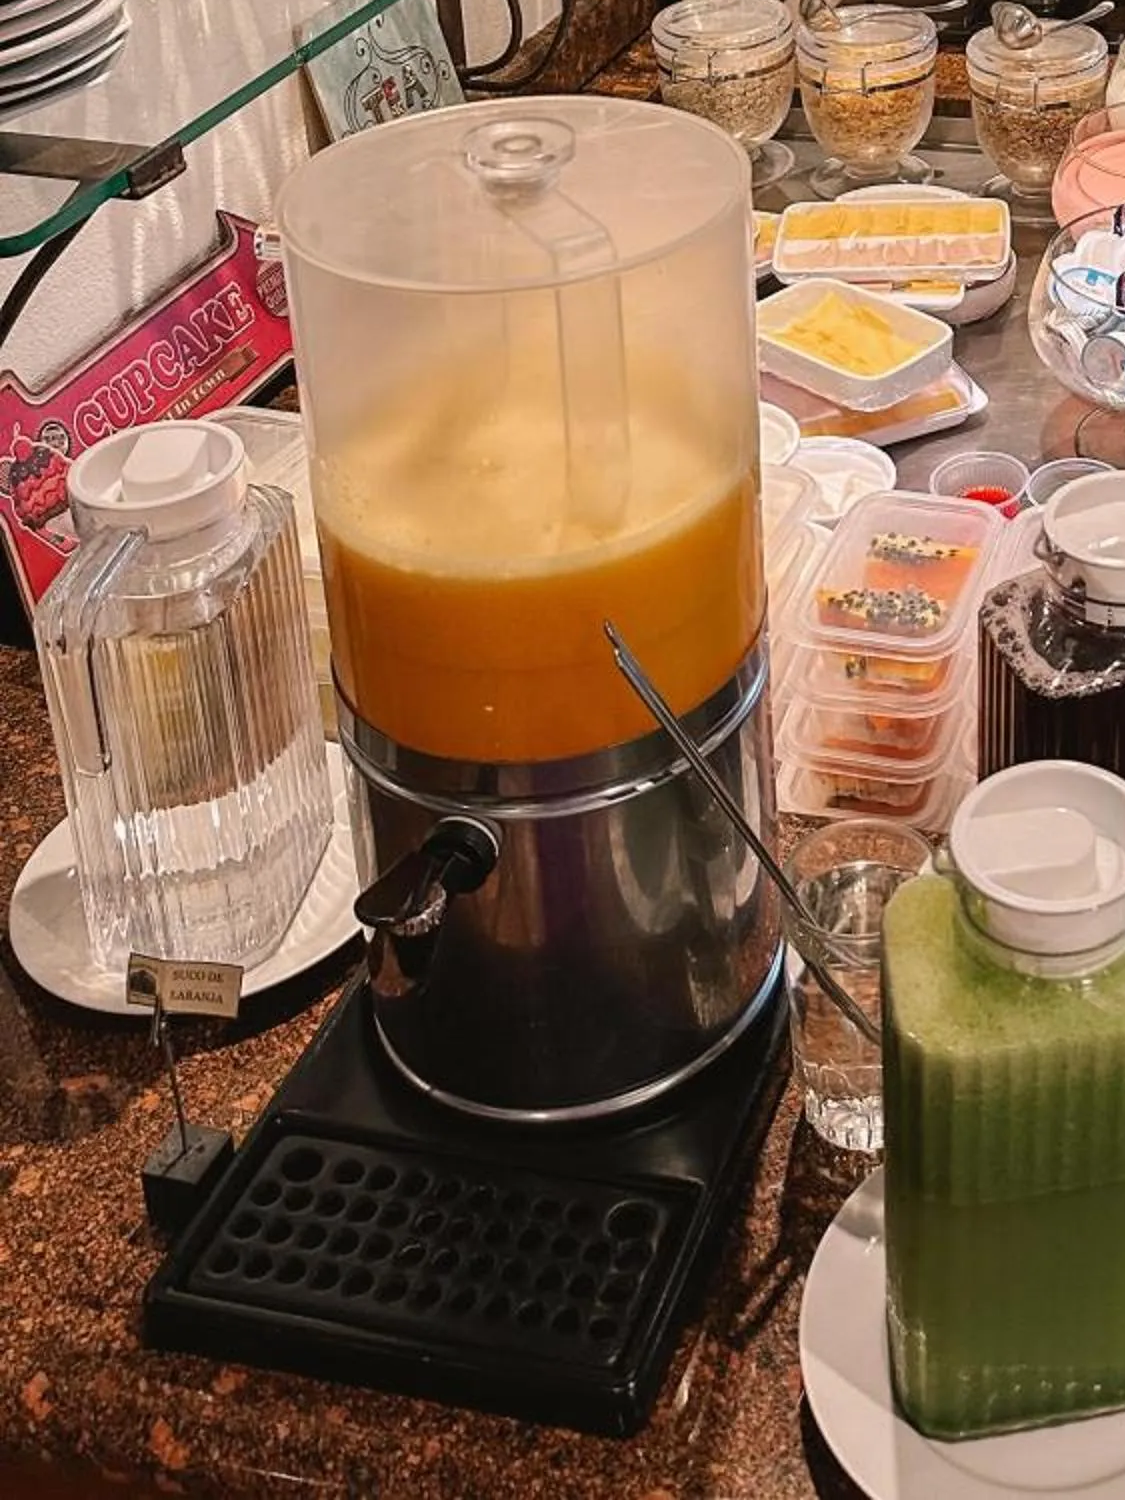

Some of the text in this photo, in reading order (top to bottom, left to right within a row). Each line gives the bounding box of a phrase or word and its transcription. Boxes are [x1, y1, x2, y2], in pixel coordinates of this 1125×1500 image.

[361, 64, 428, 124] TEA
[74, 281, 255, 448] CUPCAKE
[170, 989, 224, 1004] LARANJA
